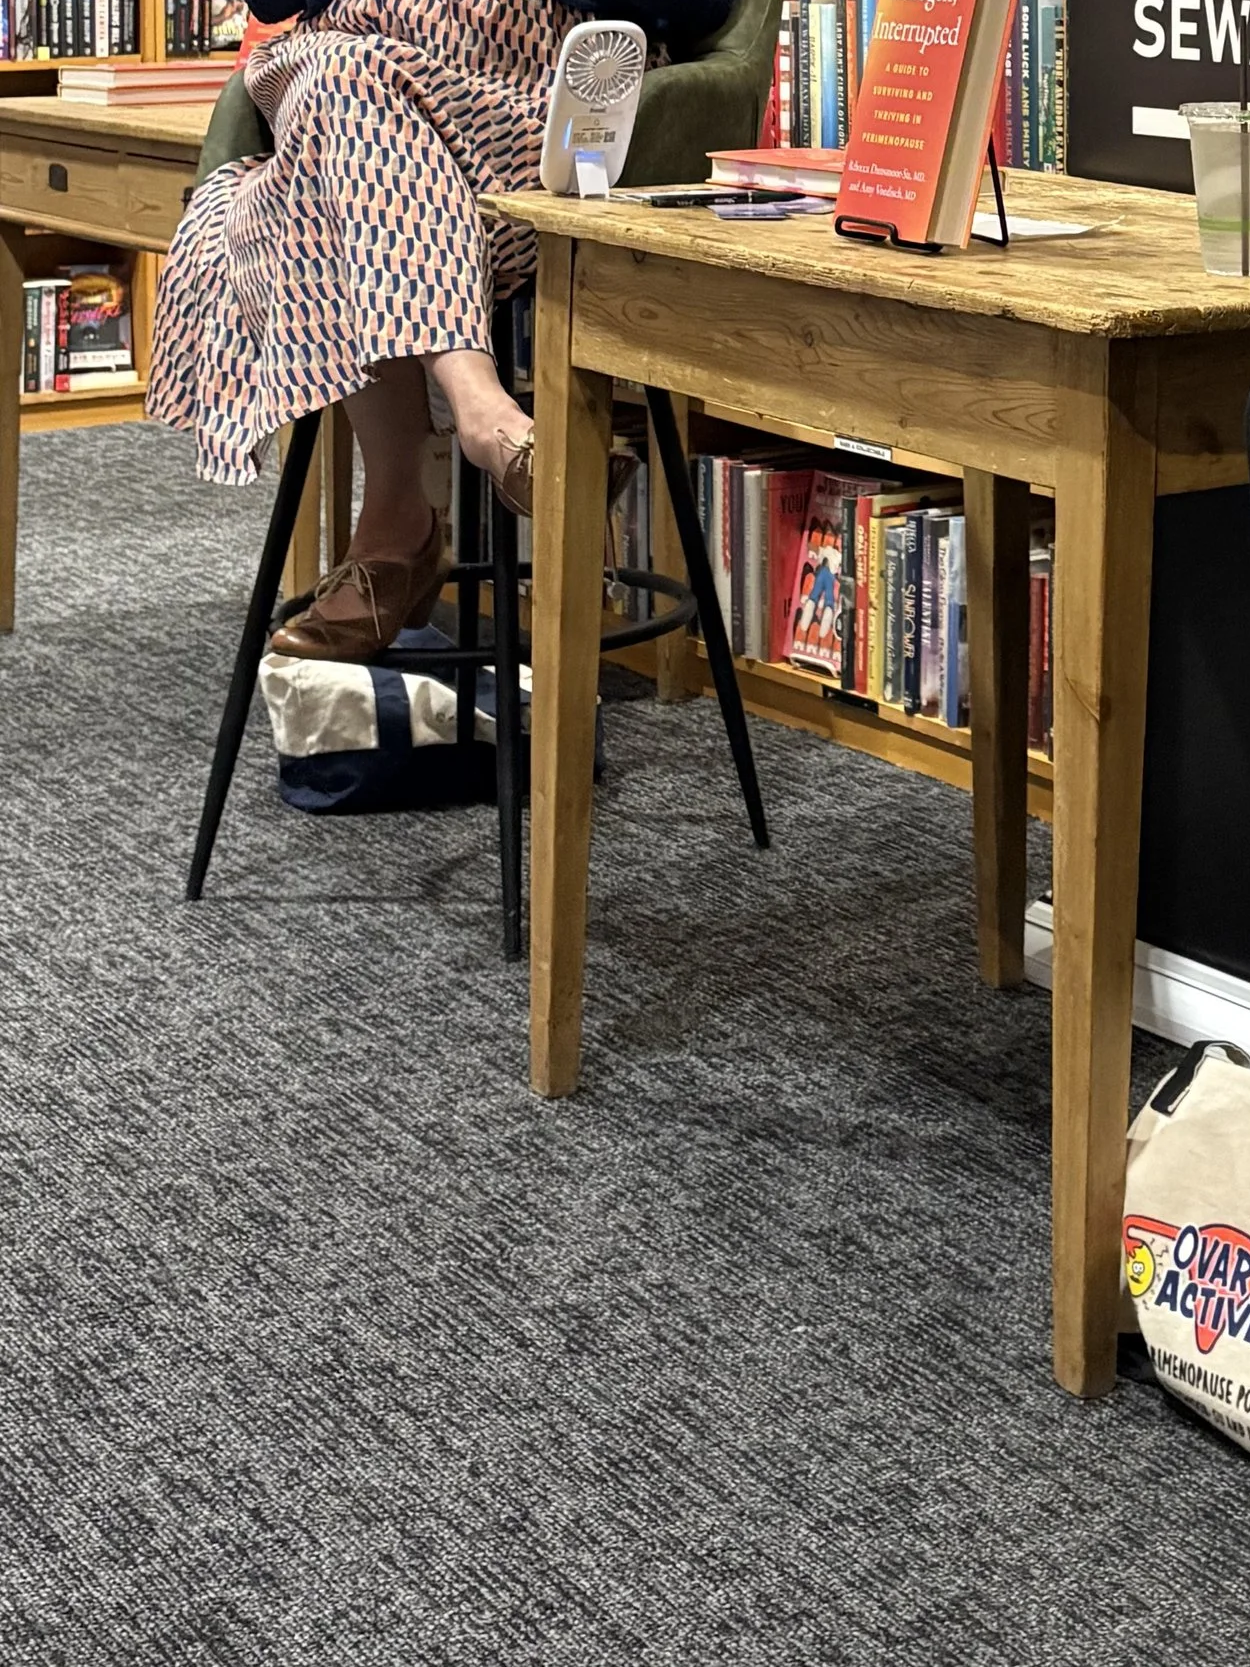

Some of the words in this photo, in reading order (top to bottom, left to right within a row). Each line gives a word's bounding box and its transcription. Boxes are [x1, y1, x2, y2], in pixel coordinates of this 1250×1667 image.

[874, 12, 962, 54] Interrupted
[1021, 5, 1030, 41] SOME
[885, 62, 892, 73] A
[893, 64, 916, 76] GUIDE
[918, 65, 929, 76] TO
[1021, 43, 1030, 79] LUCK
[873, 85, 914, 100] SURVIVING
[916, 89, 933, 102] AND
[1005, 84, 1013, 116] JANE
[1021, 83, 1030, 116] JANE
[874, 109, 911, 124] THRIVING
[913, 113, 922, 125] IN
[861, 132, 925, 151] PERIMENOPAUSE
[1005, 118, 1013, 165] SMILEY
[1021, 119, 1030, 168] SMILEY
